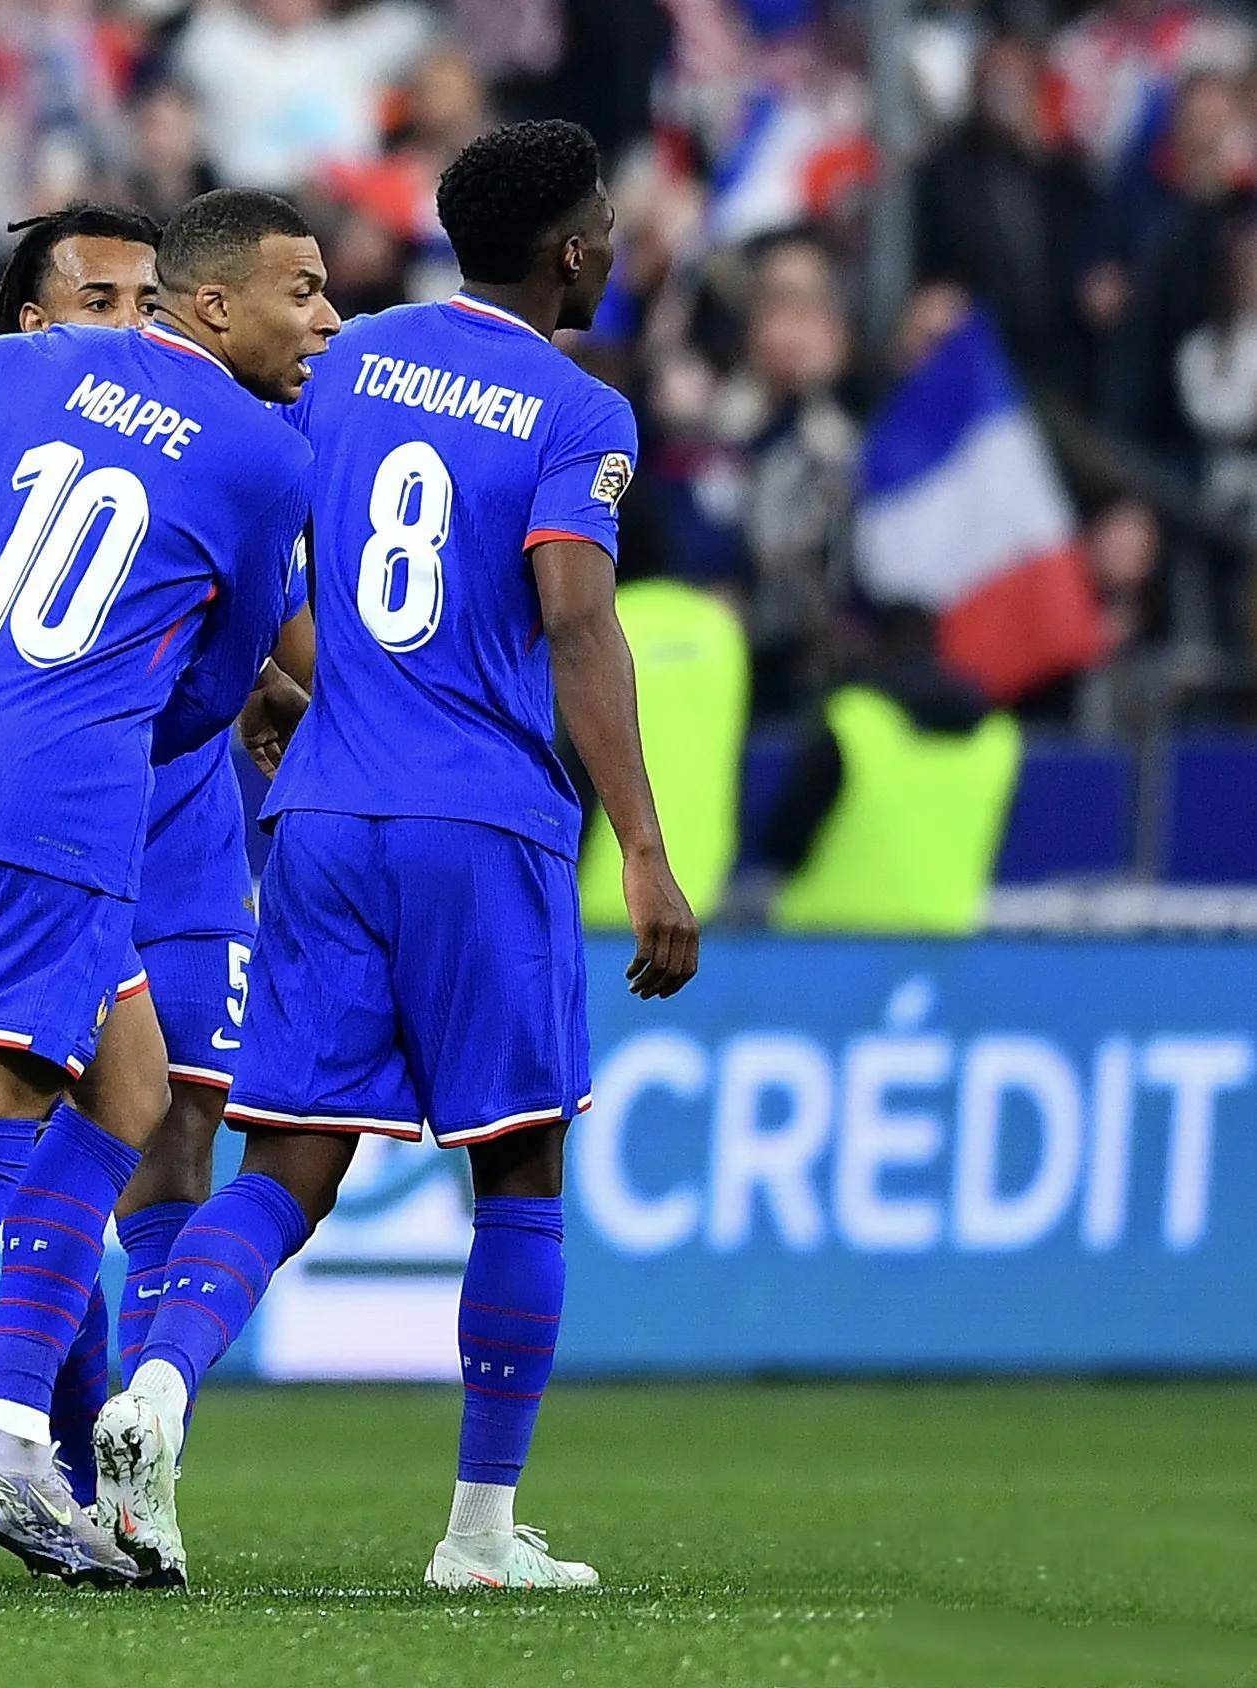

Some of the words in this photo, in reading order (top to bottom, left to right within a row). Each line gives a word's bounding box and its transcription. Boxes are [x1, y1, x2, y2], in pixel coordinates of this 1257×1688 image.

[64, 373, 202, 460] MBAPPE
[353, 353, 543, 440] TCHOUAMENI
[356, 440, 453, 653] 8
[226, 941, 252, 1028] 5
[571, 974, 1255, 1257] CRÉDIT
